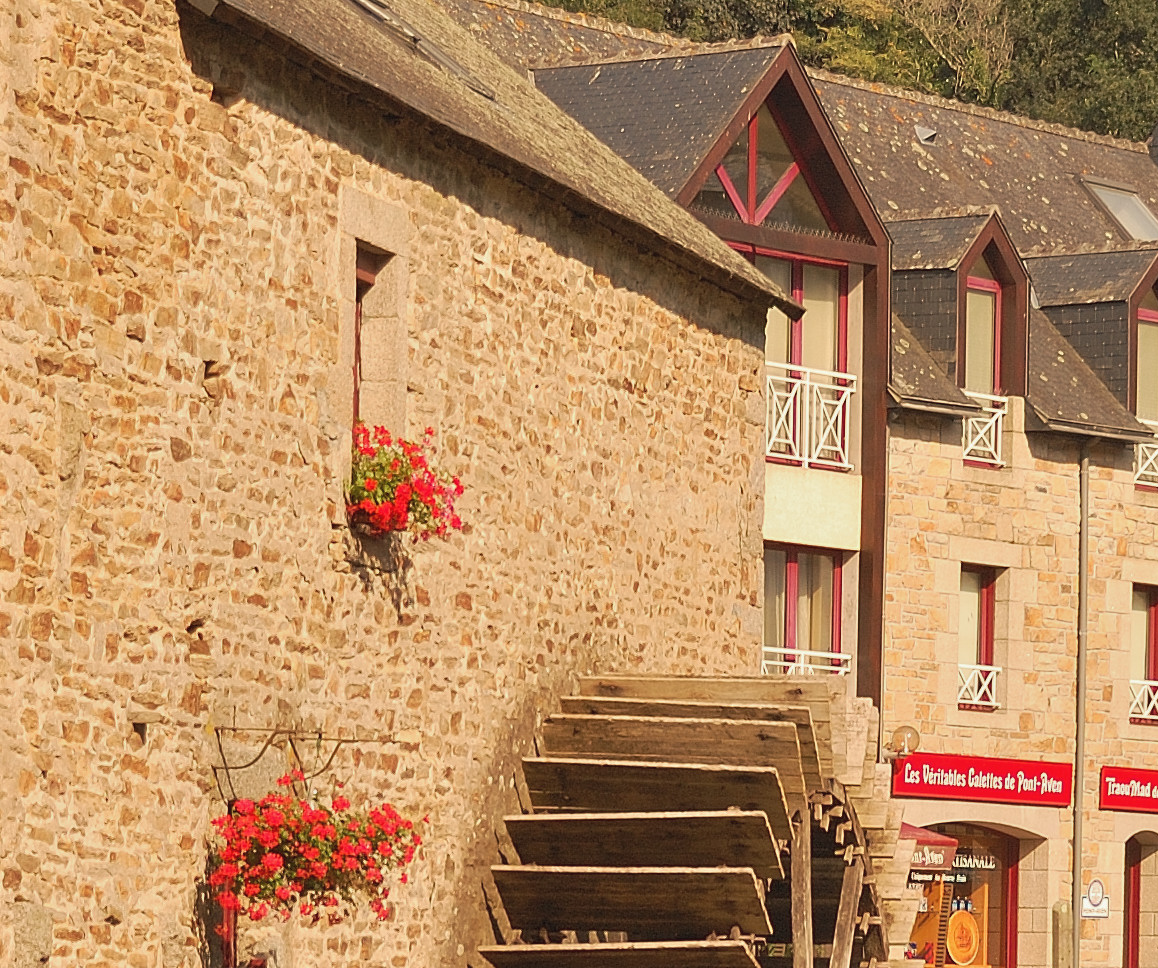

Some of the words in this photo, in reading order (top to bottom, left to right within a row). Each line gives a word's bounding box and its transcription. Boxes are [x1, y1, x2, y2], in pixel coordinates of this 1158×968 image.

[904, 763, 920, 784] Les
[922, 764, 966, 787] Véritables
[968, 767, 1003, 790] Galettes
[1004, 773, 1015, 790] de
[1017, 771, 1062, 795] Pont-Aven
